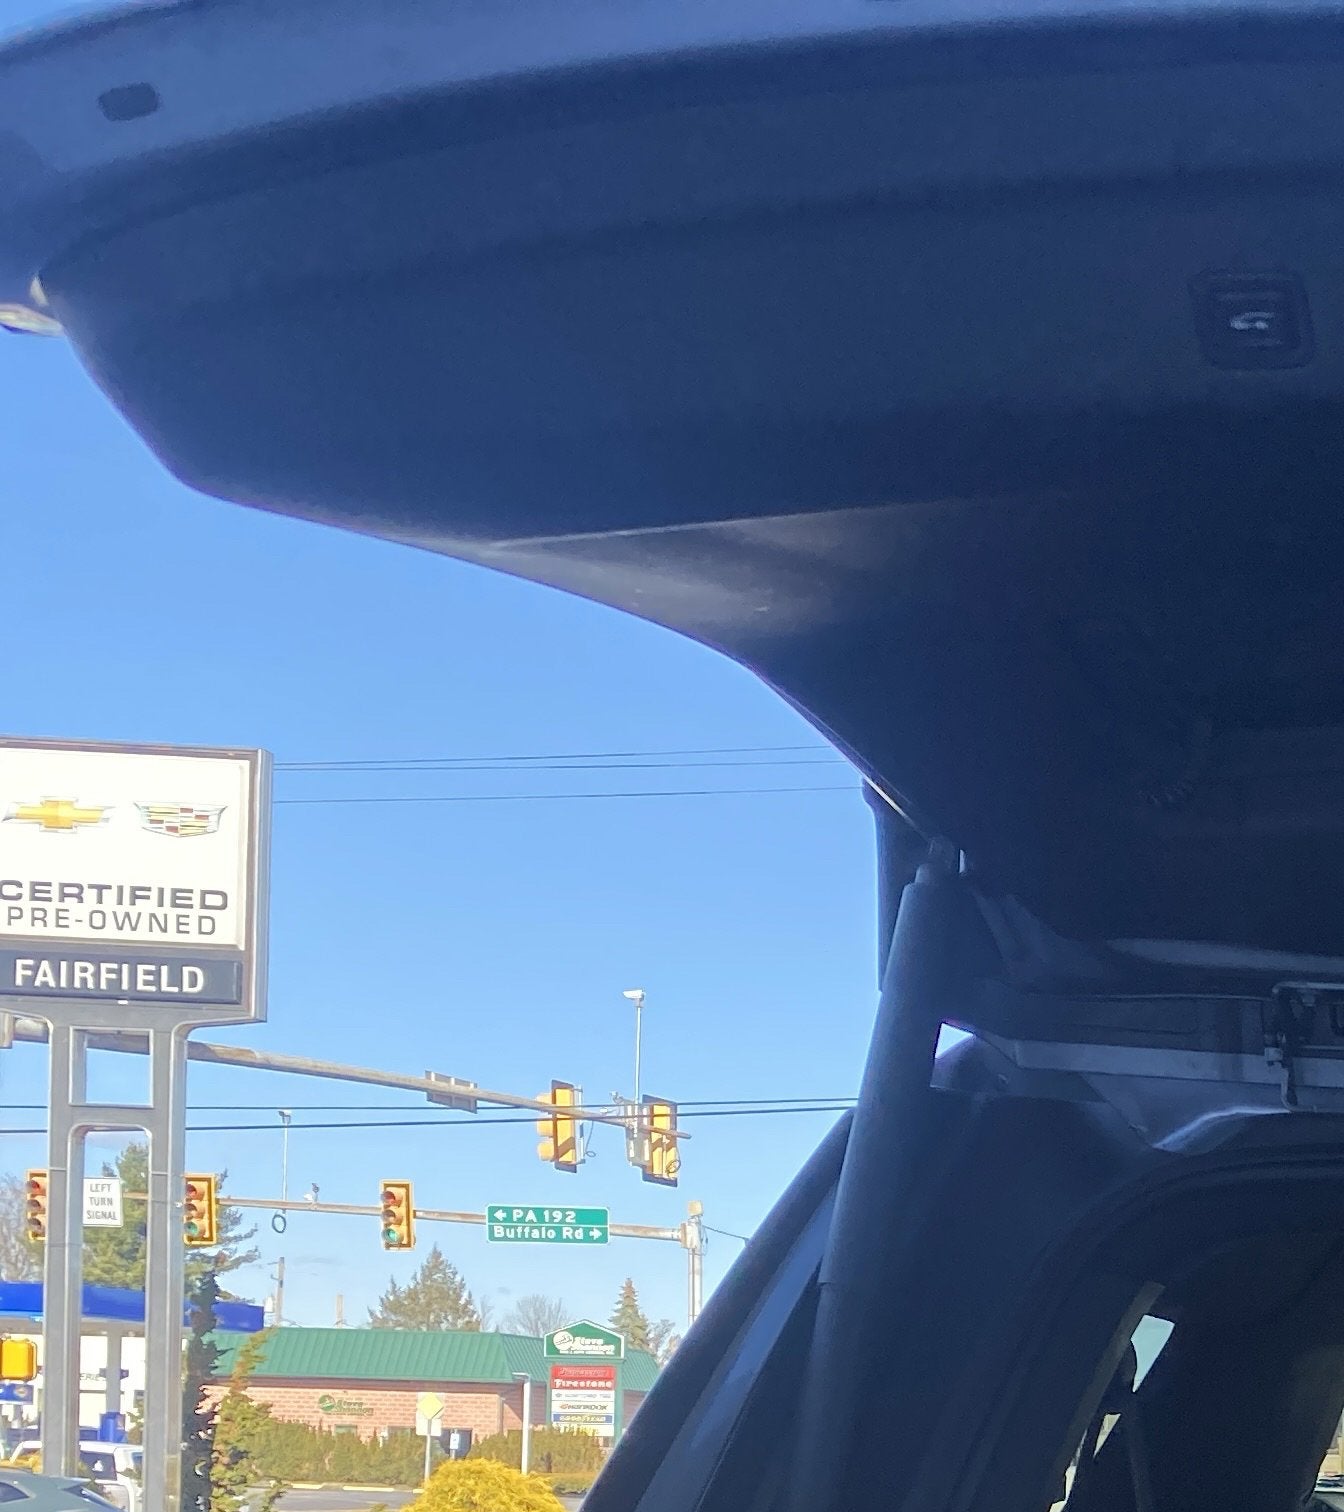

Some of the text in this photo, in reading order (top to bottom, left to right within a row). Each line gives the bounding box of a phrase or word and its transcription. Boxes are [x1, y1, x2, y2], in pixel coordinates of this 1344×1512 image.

[0, 880, 228, 910] CERTIFIED
[7, 906, 216, 936] PRE-OWNED
[15, 958, 204, 993] FAIRFIELD
[90, 1183, 111, 1192] LEFT
[89, 1196, 113, 1206] TURN
[87, 1210, 118, 1220] SIGNAL
[512, 1208, 576, 1223] PA 192
[493, 1225, 584, 1240] Buffalo Rd
[553, 1378, 612, 1389] Firestone
